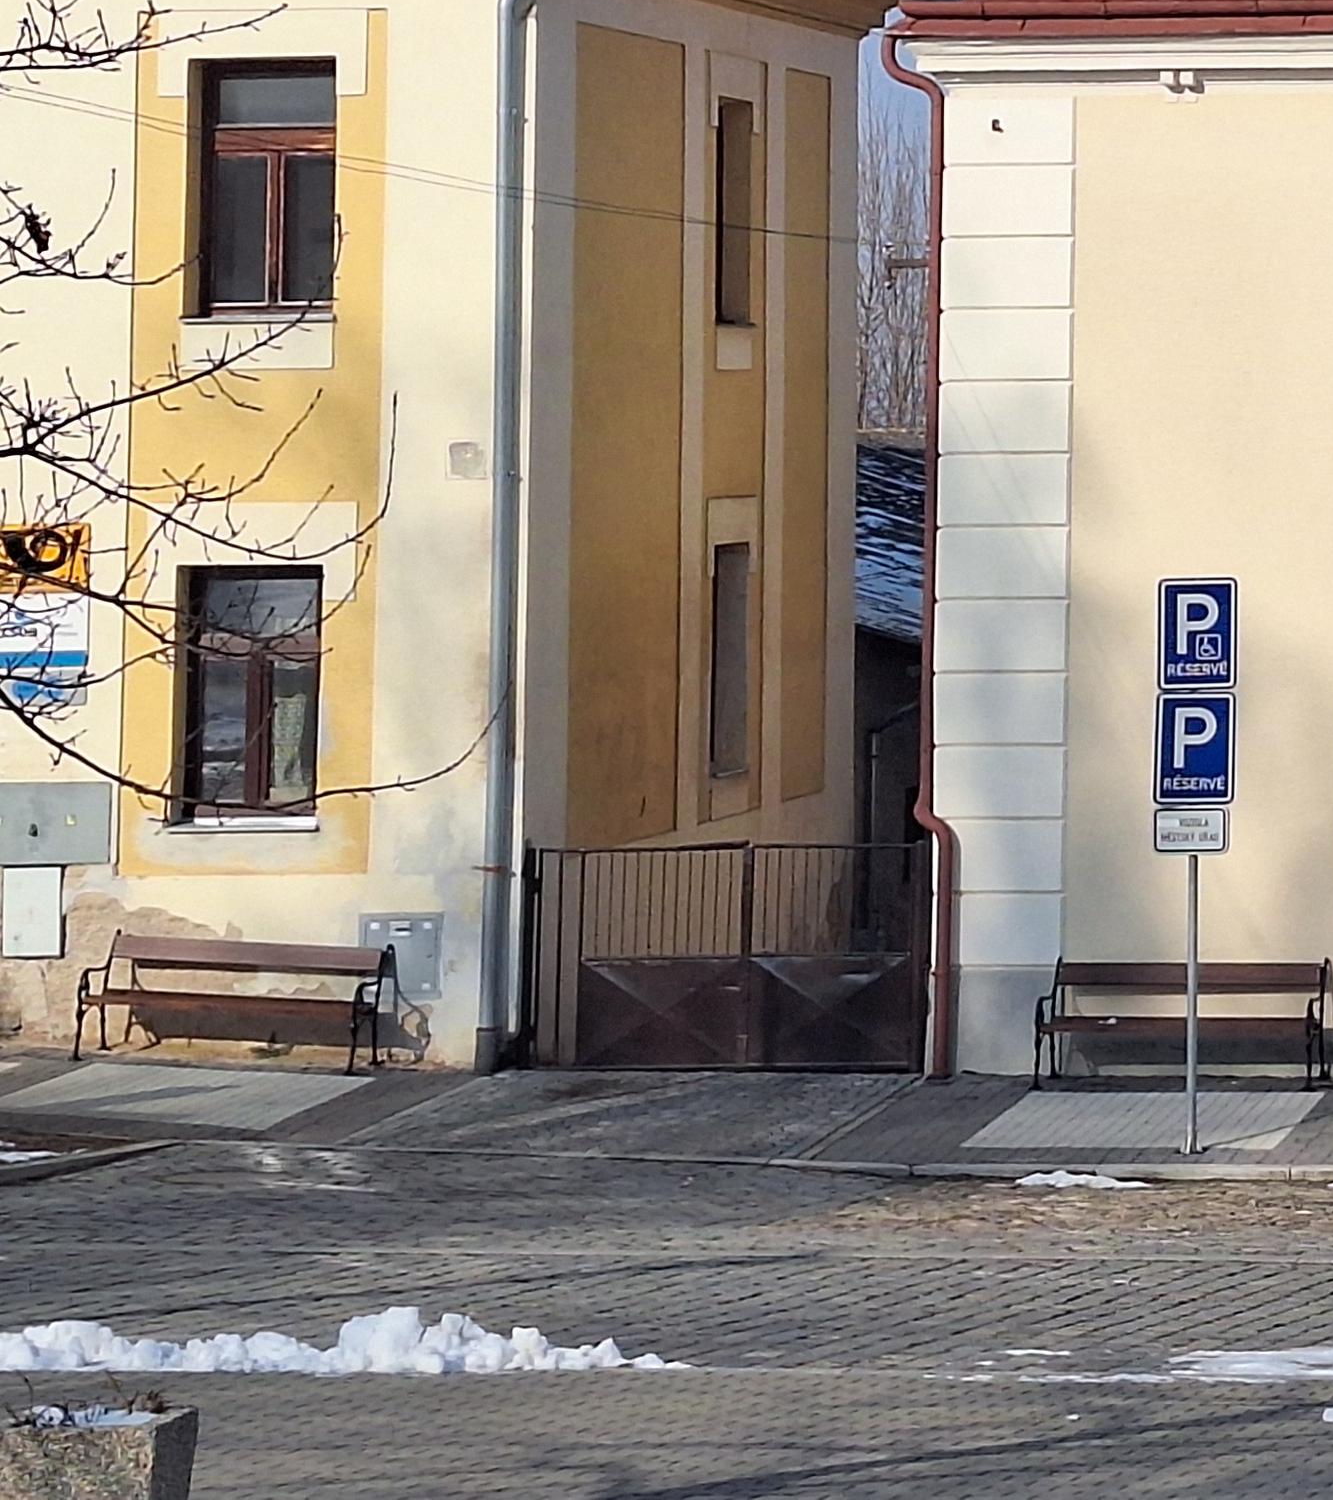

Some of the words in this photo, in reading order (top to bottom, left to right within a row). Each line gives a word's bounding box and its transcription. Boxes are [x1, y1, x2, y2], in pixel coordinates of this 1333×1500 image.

[1177, 593, 1219, 654] P
[1174, 707, 1217, 769] P
[1163, 774, 1226, 791] RÉSERVÉ
